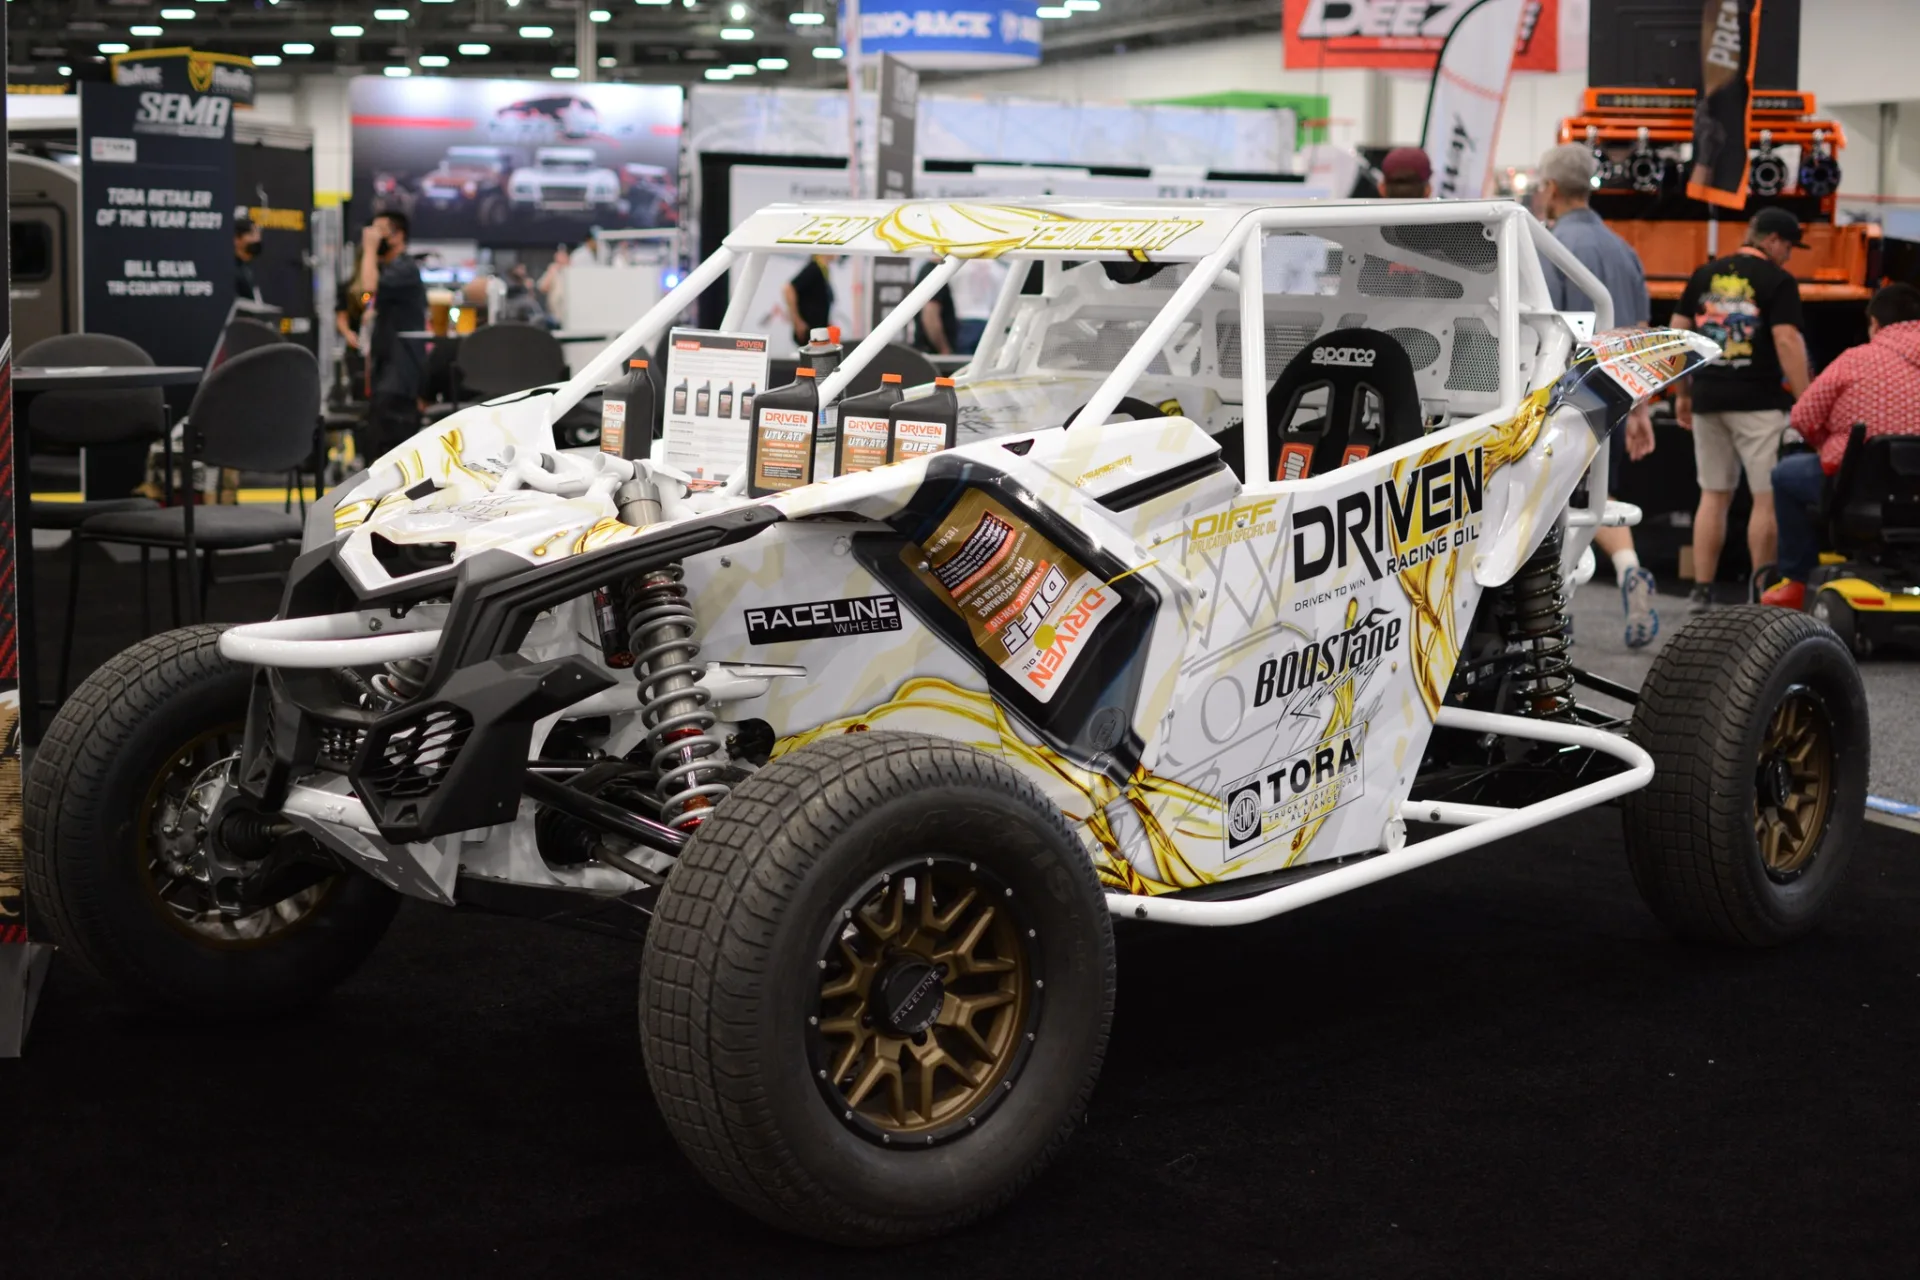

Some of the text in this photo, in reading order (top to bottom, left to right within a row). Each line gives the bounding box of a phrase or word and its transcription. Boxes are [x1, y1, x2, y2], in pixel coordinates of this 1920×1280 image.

[136, 91, 231, 127] SEMA
[107, 187, 213, 208] TORA RETAILER
[96, 208, 117, 227] OF
[119, 208, 147, 227] THE
[149, 210, 187, 228] YEAR
[188, 211, 223, 230] 2021
[124, 260, 197, 278] BILL SILVA
[107, 280, 214, 296] TRI-COUNTRY TOPS
[736, 340, 764, 349] DRIVEN
[1312, 346, 1376, 365] sparco
[765, 412, 808, 425] DRIVEN
[848, 420, 889, 432] DRIVEN
[900, 424, 942, 436] DRIVEN
[902, 441, 938, 453] DIFF
[1191, 498, 1277, 540] DIFF
[1293, 446, 1483, 583] DRIVEN
[1188, 520, 1277, 555] APPLICATION SPECIFIC OIL
[1386, 525, 1480, 576] RACING OIL
[982, 547, 996, 561] Friction
[972, 557, 1025, 608] UTV-ATV GEAR OIL
[978, 559, 1034, 617] HIGH PERFORMANCE
[990, 567, 1044, 628] SYNTHETIC 75W-110
[1295, 578, 1366, 612] DRIVEN TO WIN
[747, 597, 897, 631] RACELINE
[1001, 564, 1067, 655] DIFF
[834, 618, 899, 634] WHEELS
[1027, 588, 1106, 689] DRIVEN
[1022, 658, 1036, 670] OIL
[1267, 738, 1357, 804] TORA
[1234, 798, 1256, 833] SEMA
[1269, 805, 1298, 823] TRUCK
[1291, 795, 1339, 821] ALLIANCE
[894, 971, 939, 1024] RACELINE
